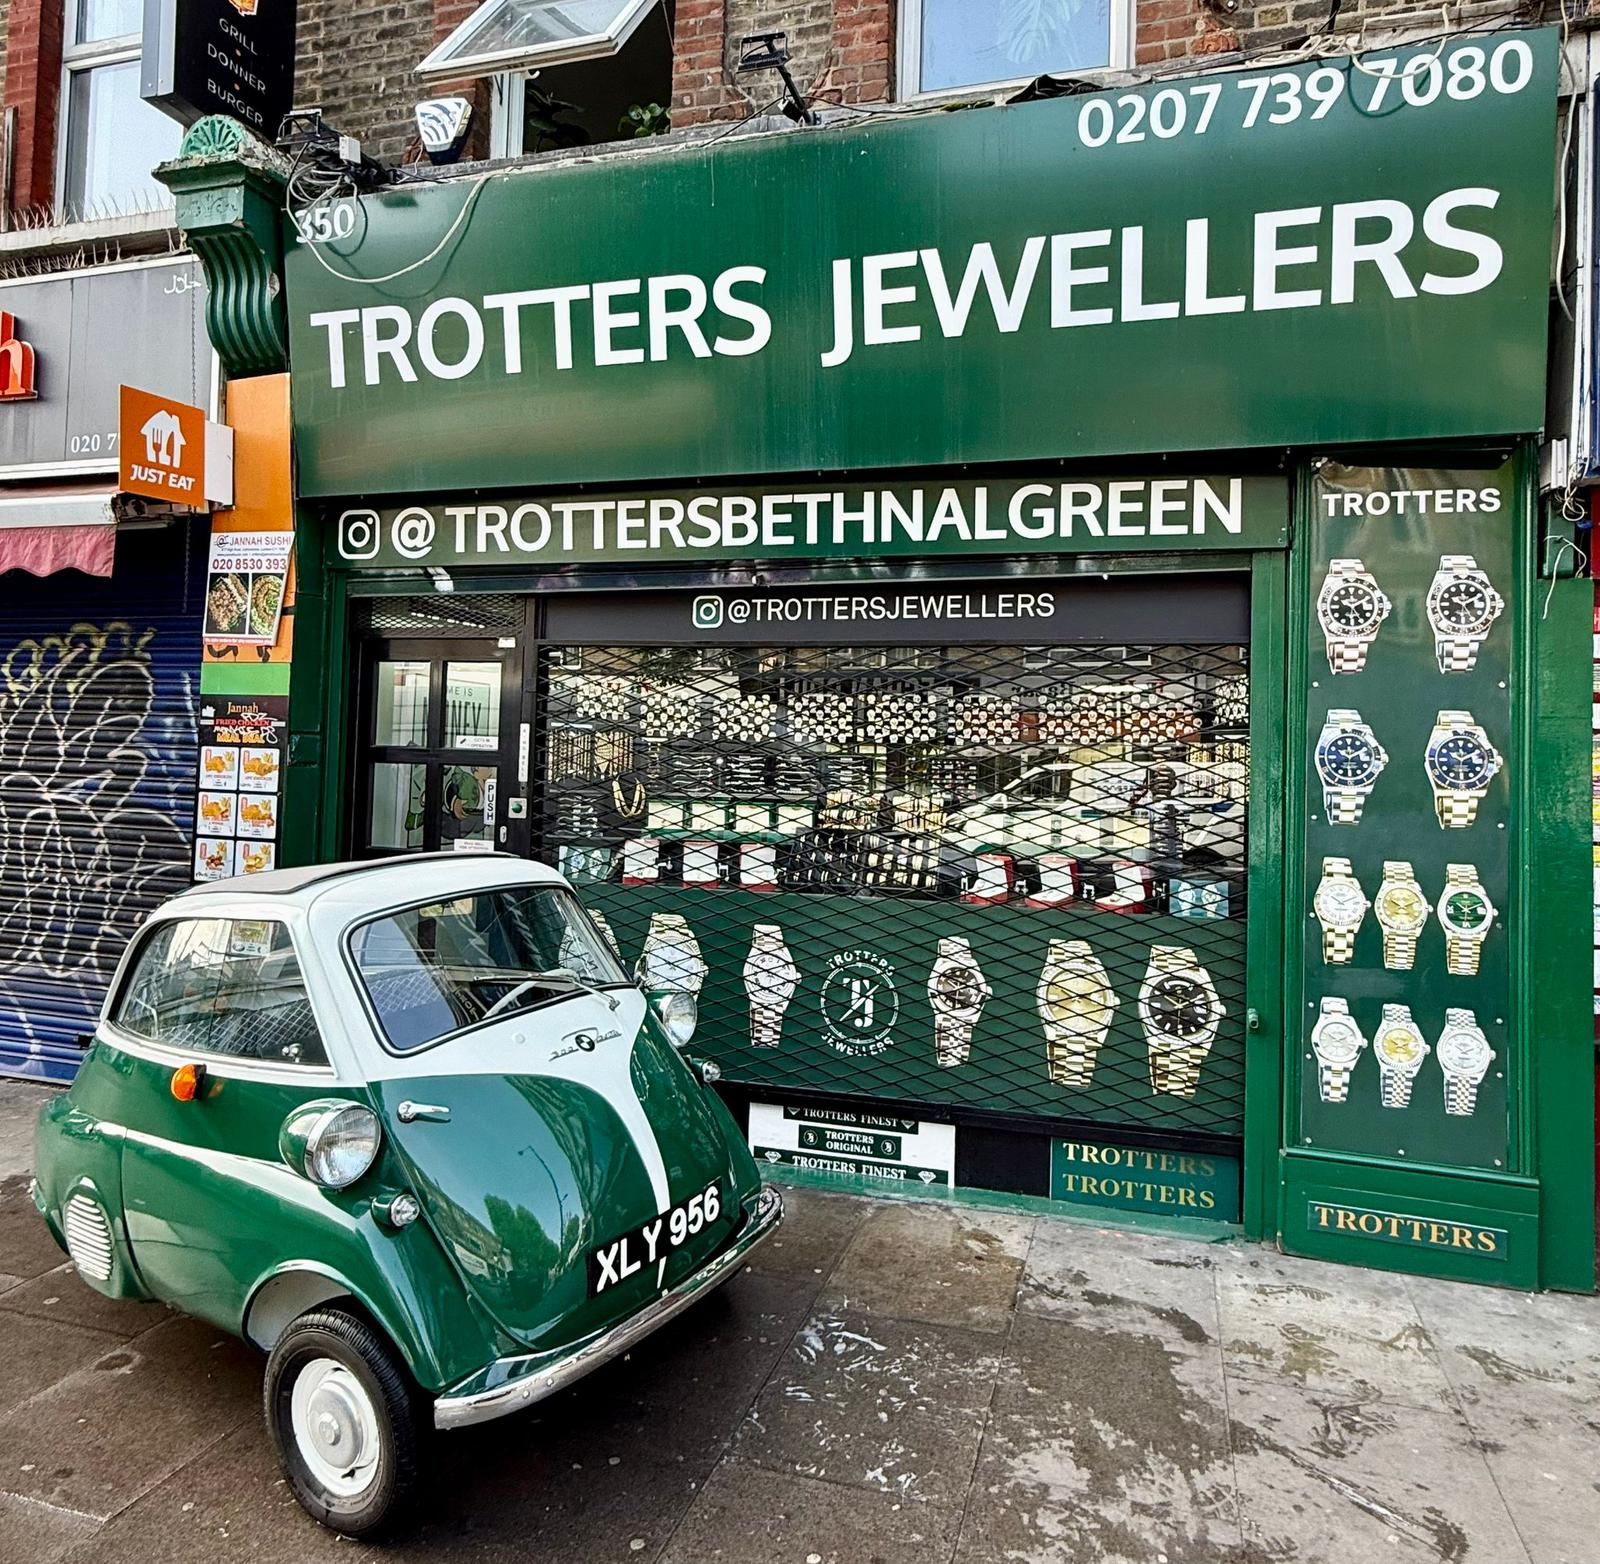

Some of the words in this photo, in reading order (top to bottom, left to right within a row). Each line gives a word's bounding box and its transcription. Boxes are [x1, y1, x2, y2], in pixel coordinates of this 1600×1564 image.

[219, 17, 258, 55] GRILL
[207, 43, 266, 95] DONNER
[207, 79, 264, 127] BURGER
[1077, 83, 1222, 148] 0207
[1237, 68, 1345, 128] 739
[1361, 39, 1534, 112] 7080
[295, 203, 355, 243] 350
[310, 265, 772, 388] TROTTERS
[820, 187, 1504, 367] JEWELLERS
[71, 434, 101, 453] 020
[107, 432, 120, 450] 7
[130, 463, 166, 486] JUST
[168, 473, 196, 492] EAT
[1321, 487, 1501, 517] TROTTERS
[229, 536, 263, 546] JANNAH
[264, 536, 291, 546] SUSHI
[212, 558, 233, 570] 020
[235, 558, 263, 570] 8530
[728, 592, 1056, 624] @TROTTERSJEWELLERS
[227, 701, 259, 715] Jannah
[486, 784, 496, 821] PUSH
[825, 950, 896, 978] TROTTERS
[820, 1032, 895, 1057] JEWELLERS
[803, 1107, 857, 1122] TROTTERS
[861, 1114, 899, 1128] FINEST
[825, 1130, 874, 1145] TROTTERS
[825, 1140, 874, 1155] ORIGINAL
[792, 1155, 856, 1174] TROTTERS
[861, 1164, 907, 1181] FINEST
[1063, 1142, 1216, 1178] TROTTERS
[1063, 1172, 1216, 1209] TROTTERS
[596, 1219, 663, 1293] XLY
[669, 1185, 720, 1246] 956
[1314, 1205, 1497, 1252] TROTTERS
